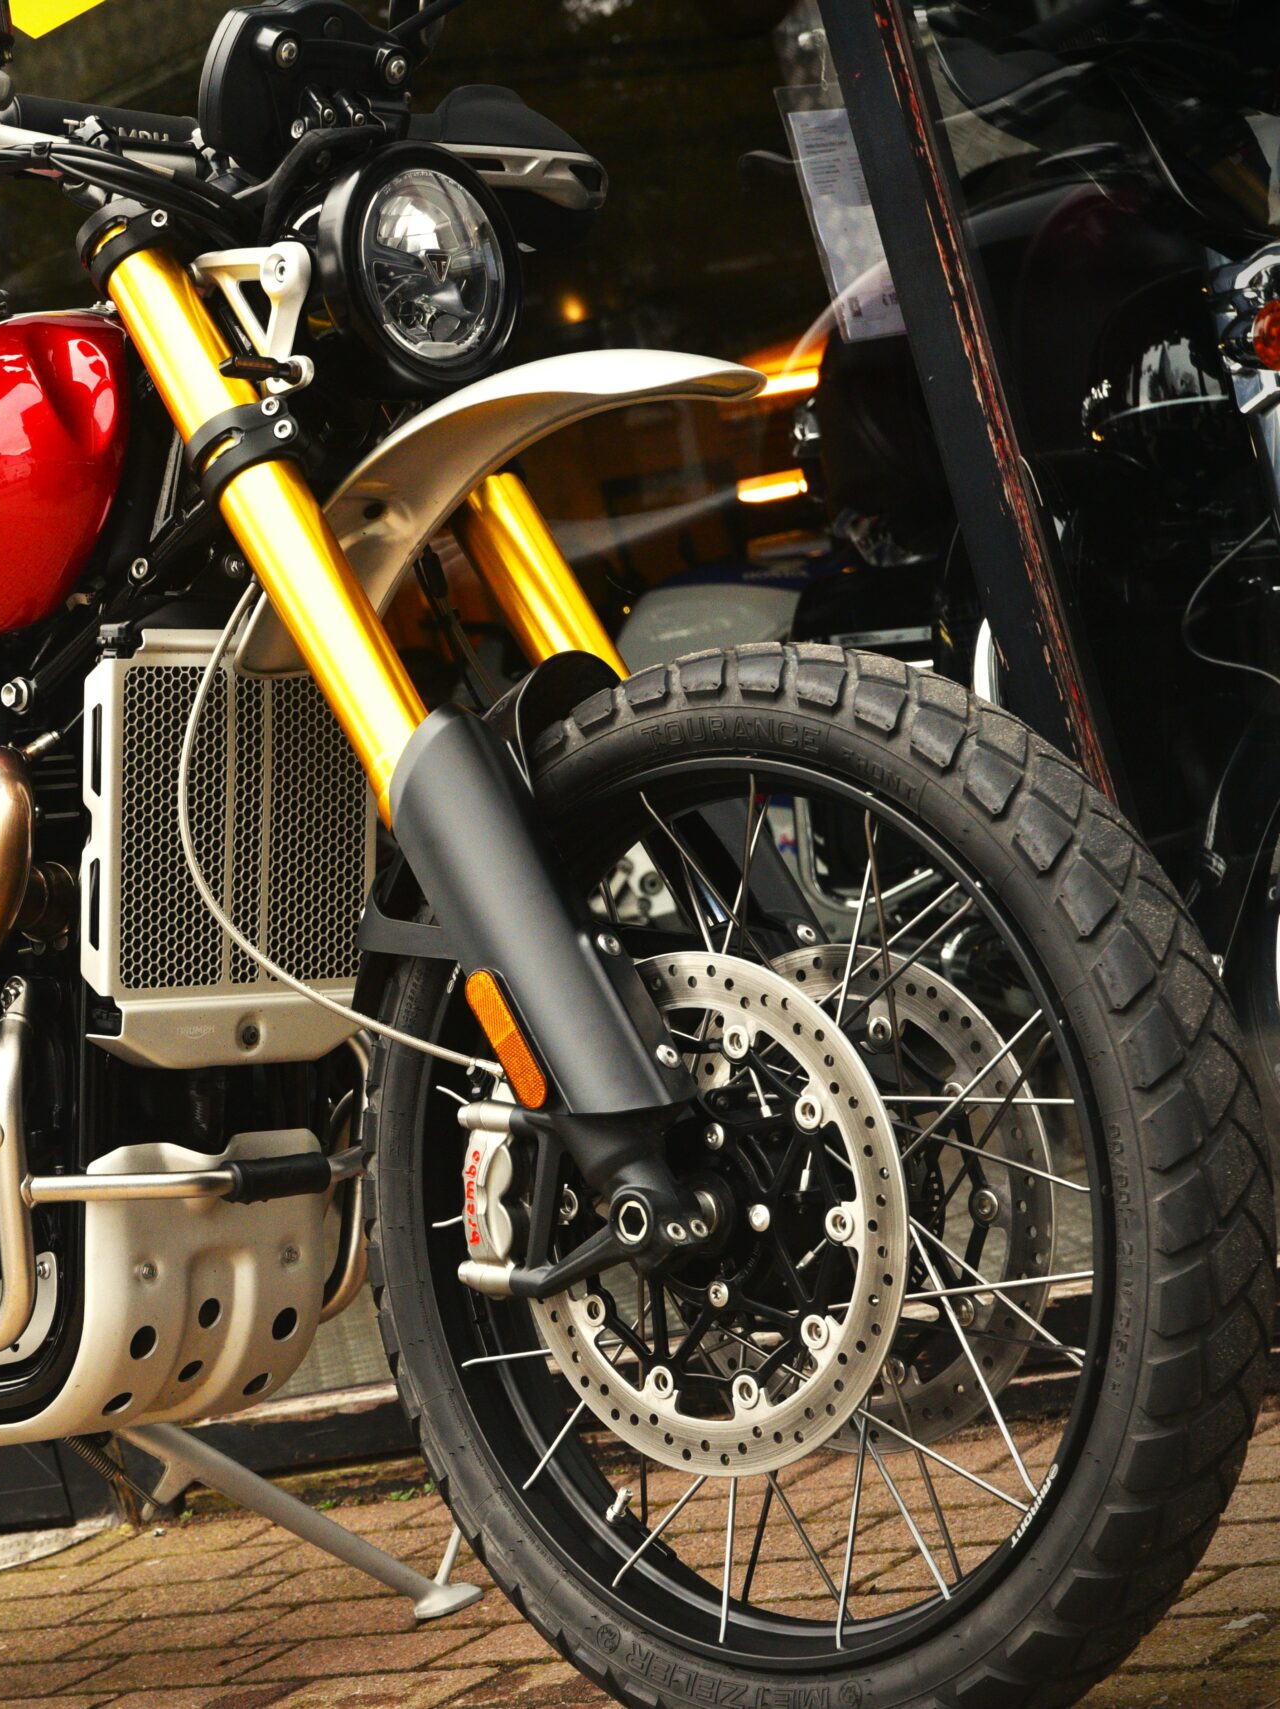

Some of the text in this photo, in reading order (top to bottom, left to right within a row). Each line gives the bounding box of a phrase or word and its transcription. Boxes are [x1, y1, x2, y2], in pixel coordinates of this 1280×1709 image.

[640, 714, 821, 752] TOURANCE
[840, 746, 920, 799] FRONT
[465, 1151, 481, 1246] brembo
[625, 1640, 830, 1709] METZELER
